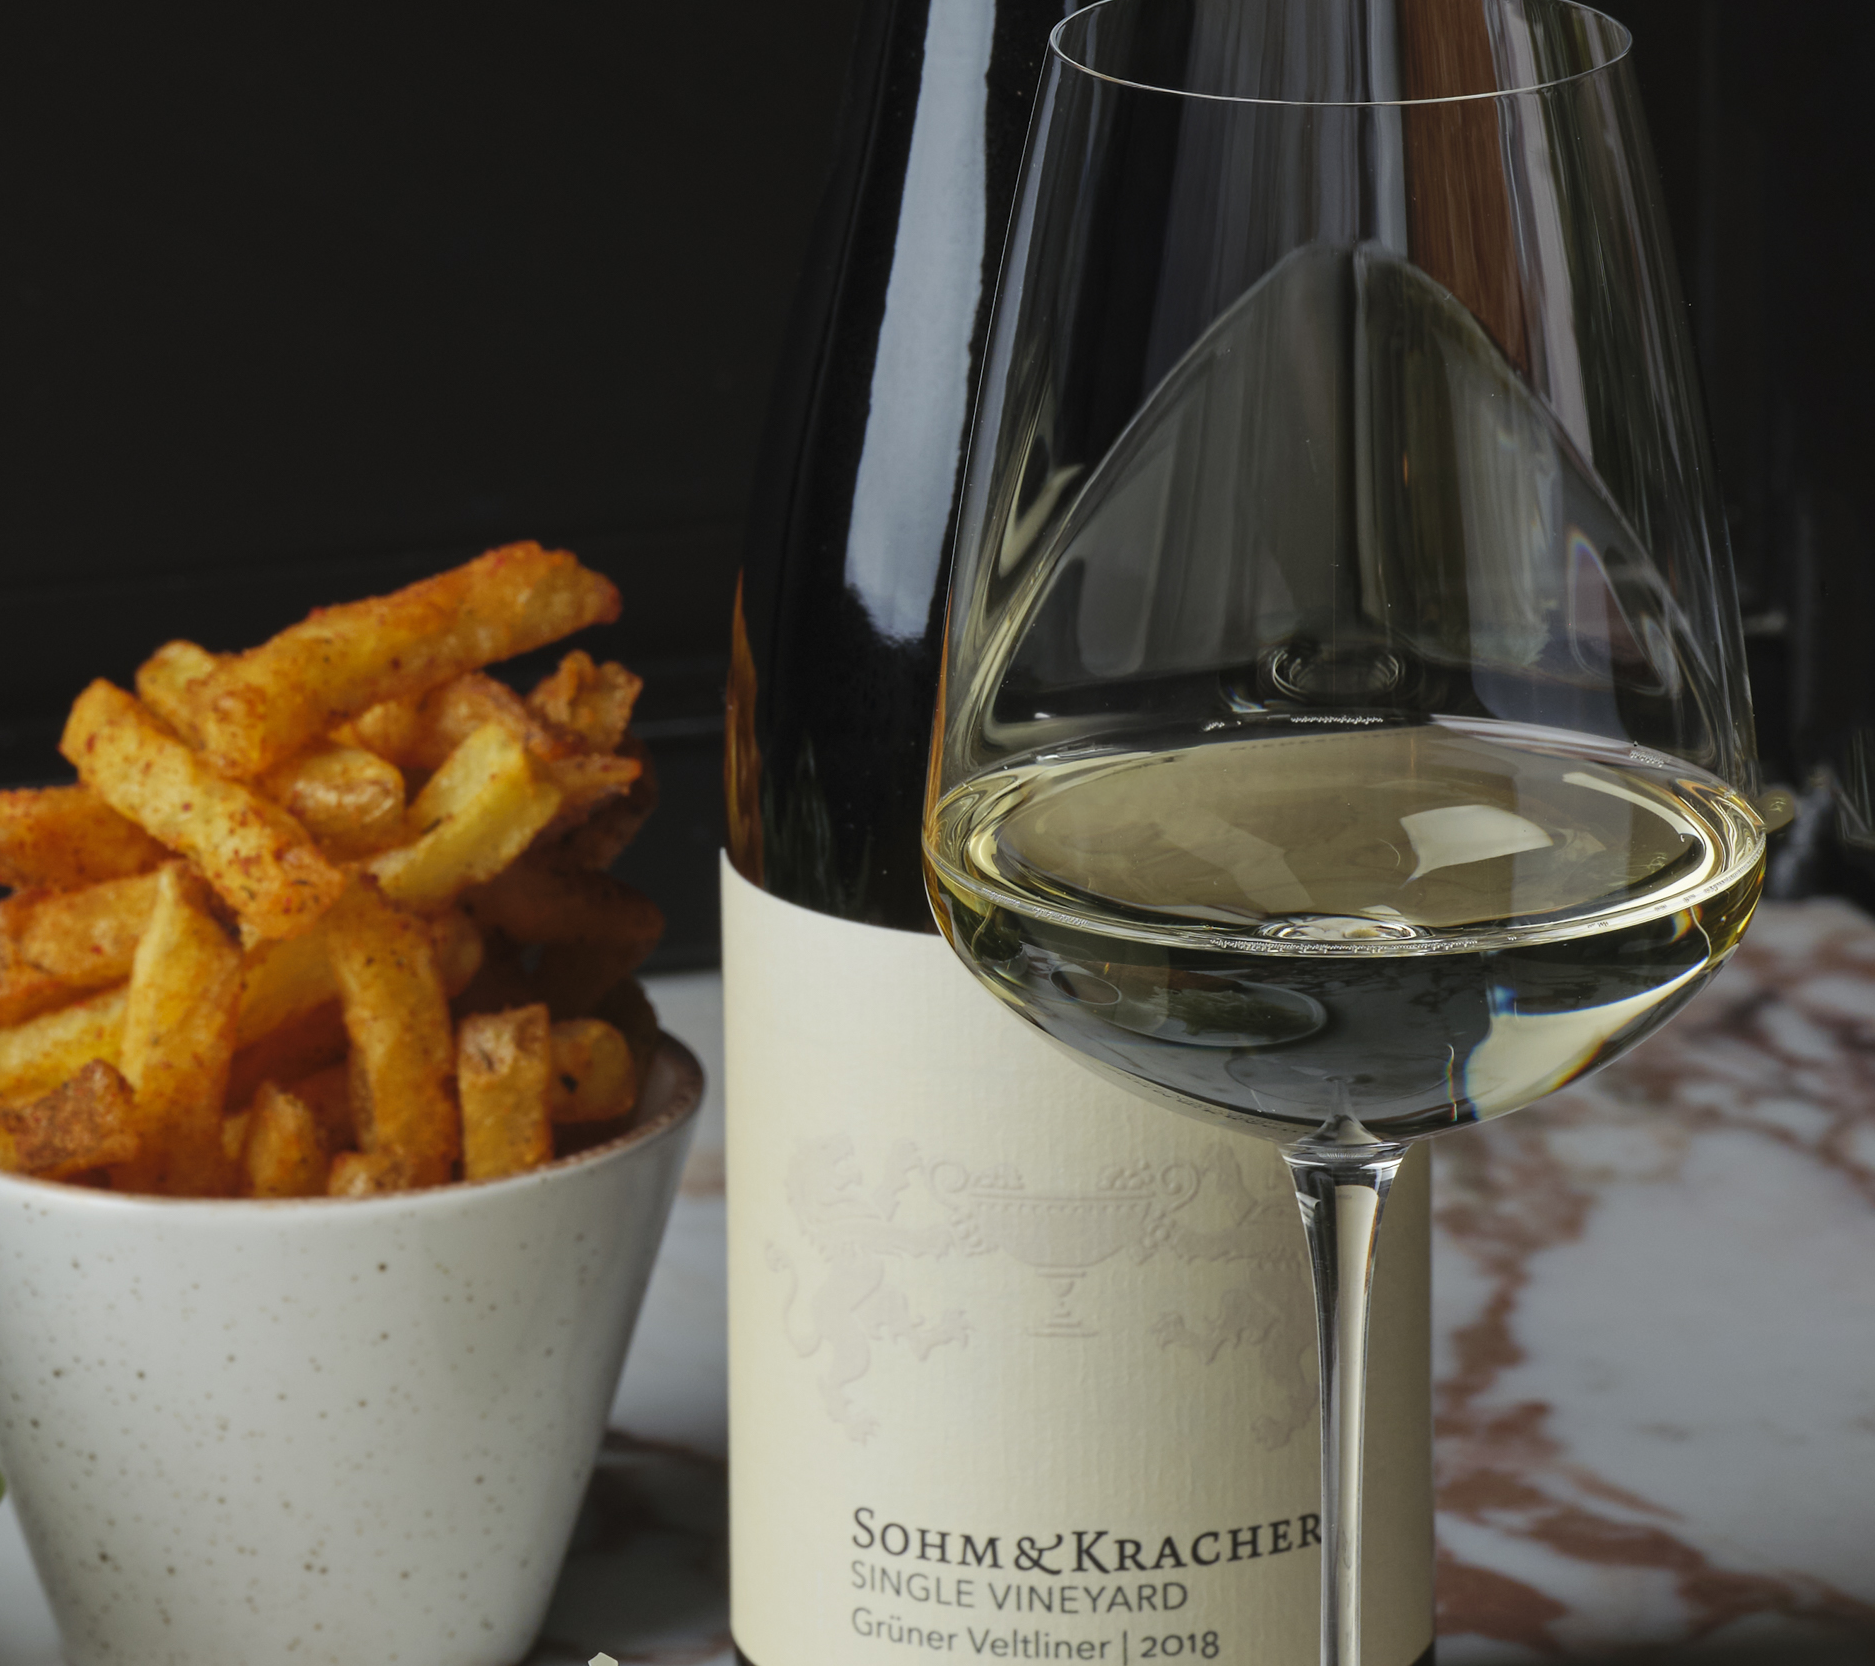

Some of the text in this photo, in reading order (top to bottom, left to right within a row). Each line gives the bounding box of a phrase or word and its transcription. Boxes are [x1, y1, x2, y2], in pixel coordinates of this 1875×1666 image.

[850, 1559, 1188, 1614] SINGLE VINEYARD
[850, 1606, 959, 1652] Grüner
[966, 1626, 1112, 1660] Veltliner
[1139, 1630, 1221, 1660] 2018
